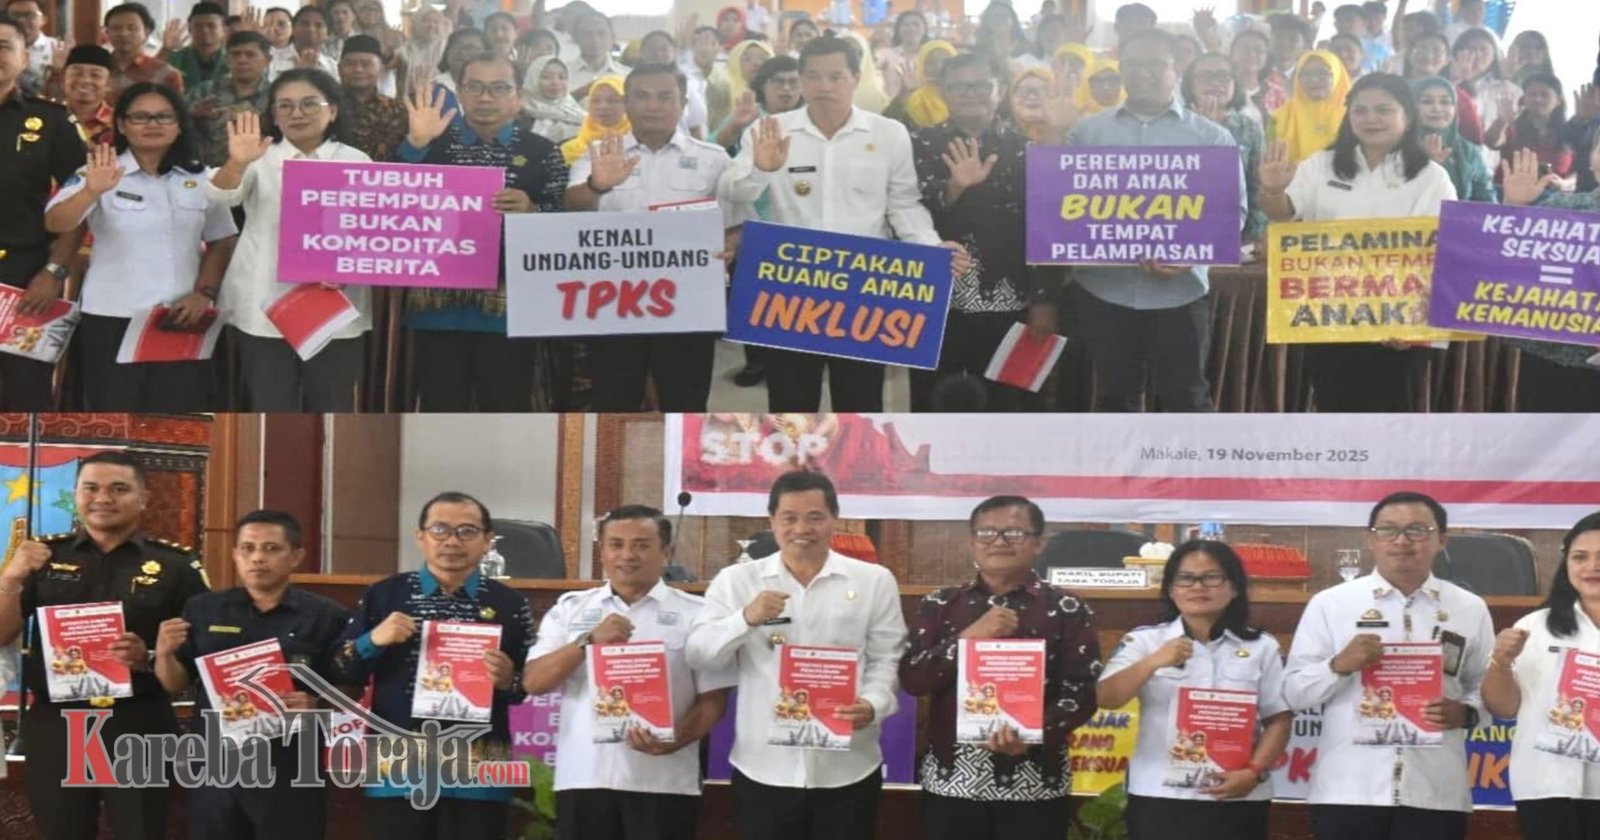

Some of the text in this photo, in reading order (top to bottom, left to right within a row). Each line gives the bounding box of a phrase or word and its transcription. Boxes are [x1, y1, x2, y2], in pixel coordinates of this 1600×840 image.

[1059, 153, 1201, 171] PEREMPUAN
[343, 169, 444, 189] TUBUH
[1073, 173, 1188, 190] DAN ANAK
[301, 190, 482, 212] PEREMPUAN
[1060, 194, 1206, 221] BUKAN
[339, 212, 443, 233] BUKAN
[1087, 224, 1178, 240] TEMPAT
[302, 233, 477, 256] KOMODITAS
[578, 228, 653, 248] KENALI
[523, 249, 710, 272] UNDANG-UNDANG
[777, 242, 924, 280] CIPTAKAN
[1051, 243, 1214, 261] PELAMPIASAN
[1280, 254, 1363, 272] BUKAN
[336, 256, 440, 277] BERITA
[758, 262, 935, 303] RUANG AMAN
[556, 279, 677, 320] TPKS
[1474, 281, 1600, 312] KEJAHAT
[749, 291, 925, 349] INKLUSI
[1289, 302, 1408, 327] ANAK
[700, 432, 829, 466] STOP
[1140, 447, 1369, 463] Makale, 19 November 2025
